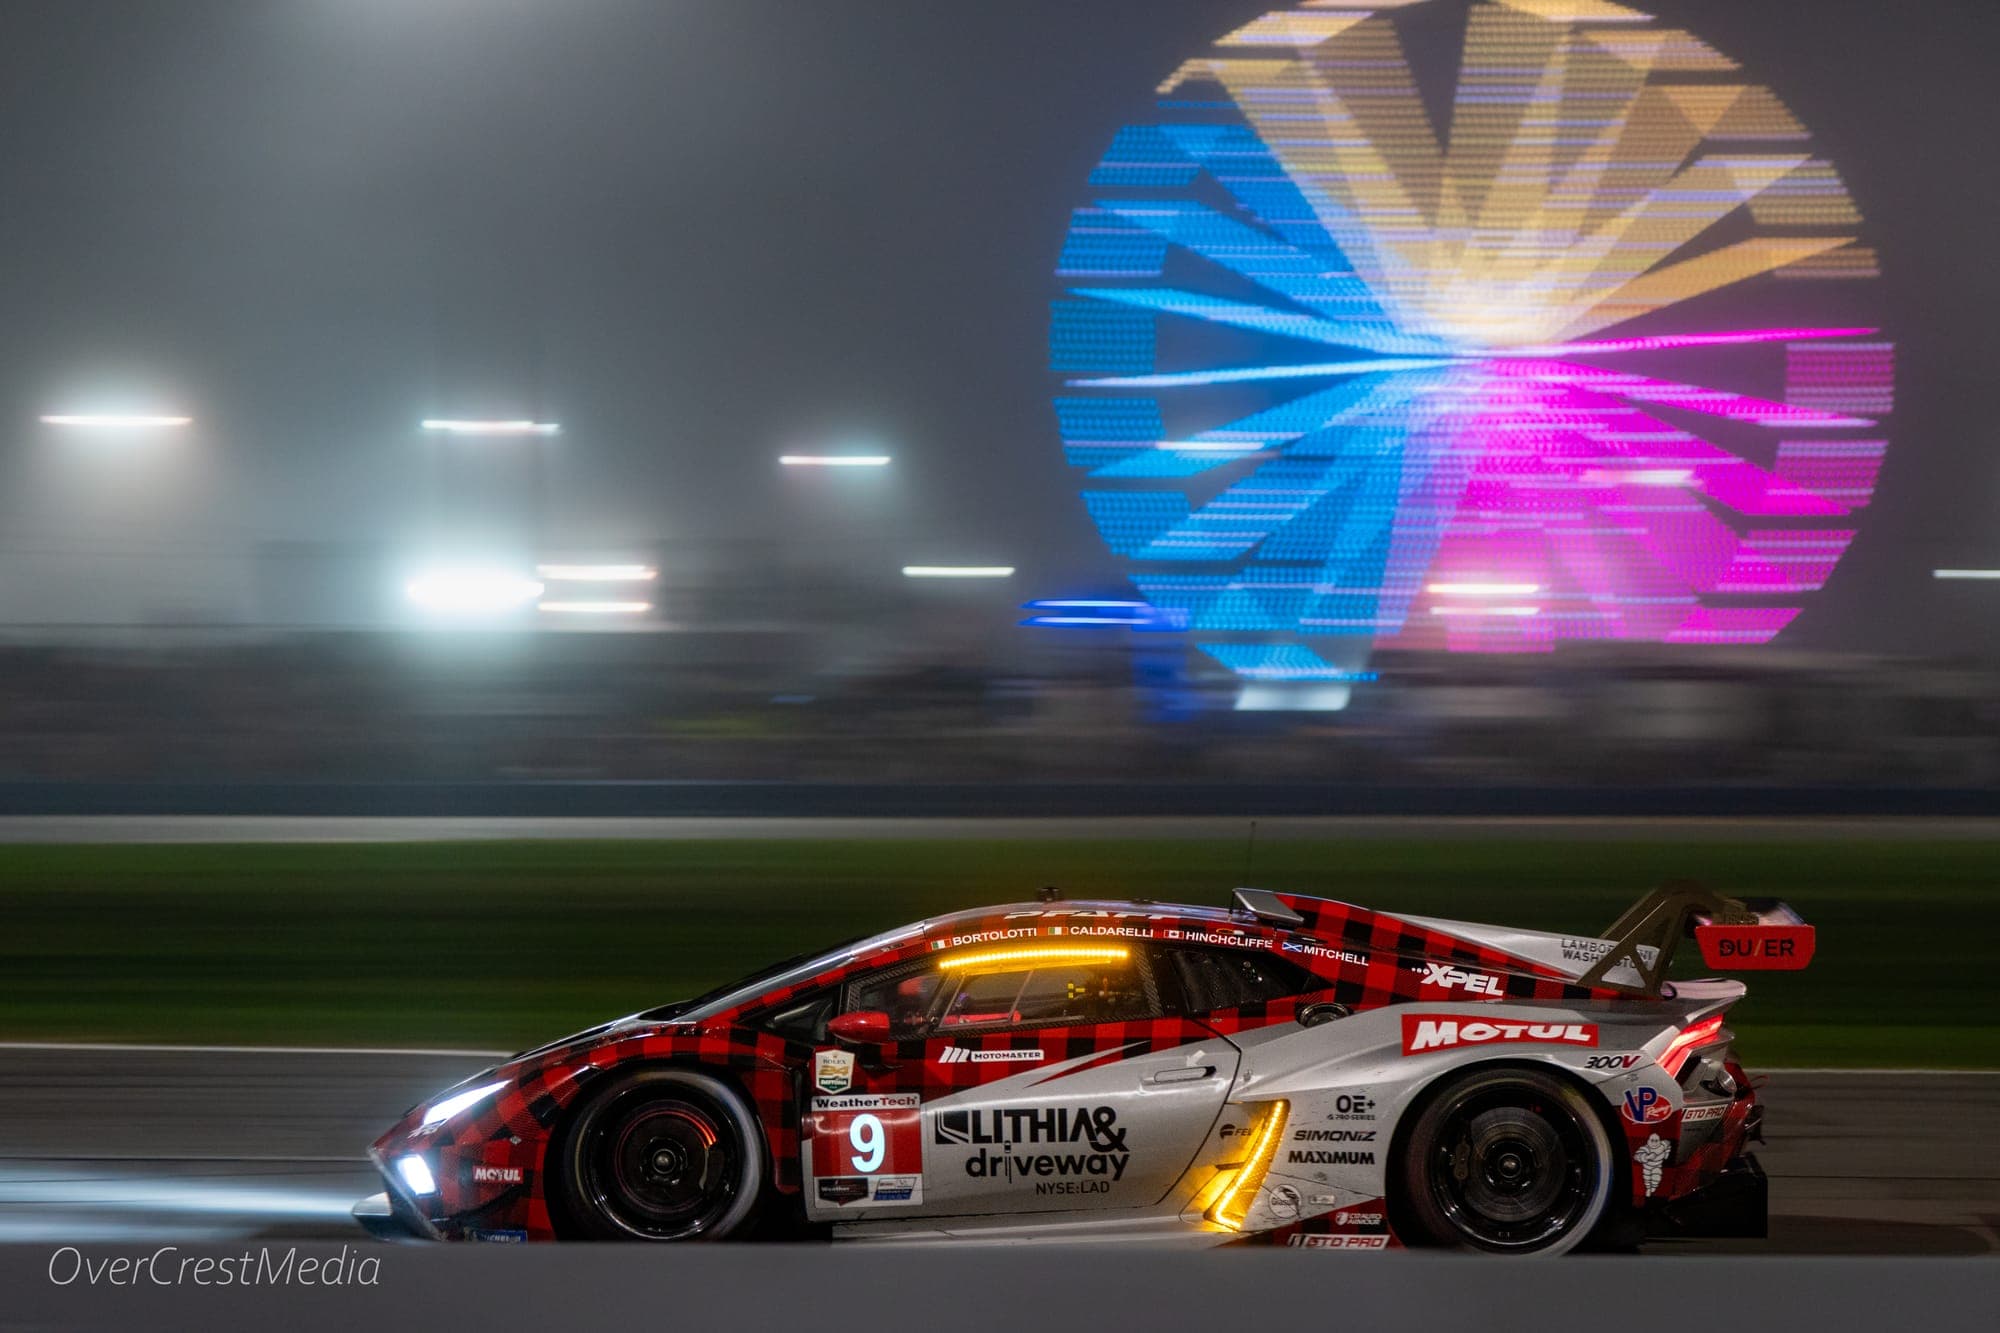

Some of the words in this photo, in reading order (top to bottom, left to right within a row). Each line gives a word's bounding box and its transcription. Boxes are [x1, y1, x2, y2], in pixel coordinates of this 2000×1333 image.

[952, 927, 1037, 946] BORTOLOTTI
[1070, 926, 1154, 938] CALDARELLI
[1186, 931, 1273, 950] HINCHCLIFFE
[1303, 945, 1369, 967] MITCHELL
[1426, 963, 1504, 996] XPEL
[1410, 1021, 1592, 1050] MOTUL
[974, 1050, 1042, 1061] MOTOMASTER
[1584, 1055, 1641, 1069] 300V
[816, 1096, 916, 1108] WeatherTech
[1336, 1095, 1376, 1113] OE+
[1624, 1086, 1658, 1122] VP
[849, 1113, 885, 1173] 9
[965, 1143, 1130, 1183] driveway
[1288, 1150, 1375, 1165] MAXIMUM
[474, 1167, 521, 1181] MOTUL
[1036, 1181, 1110, 1194] NYSE:LAD
